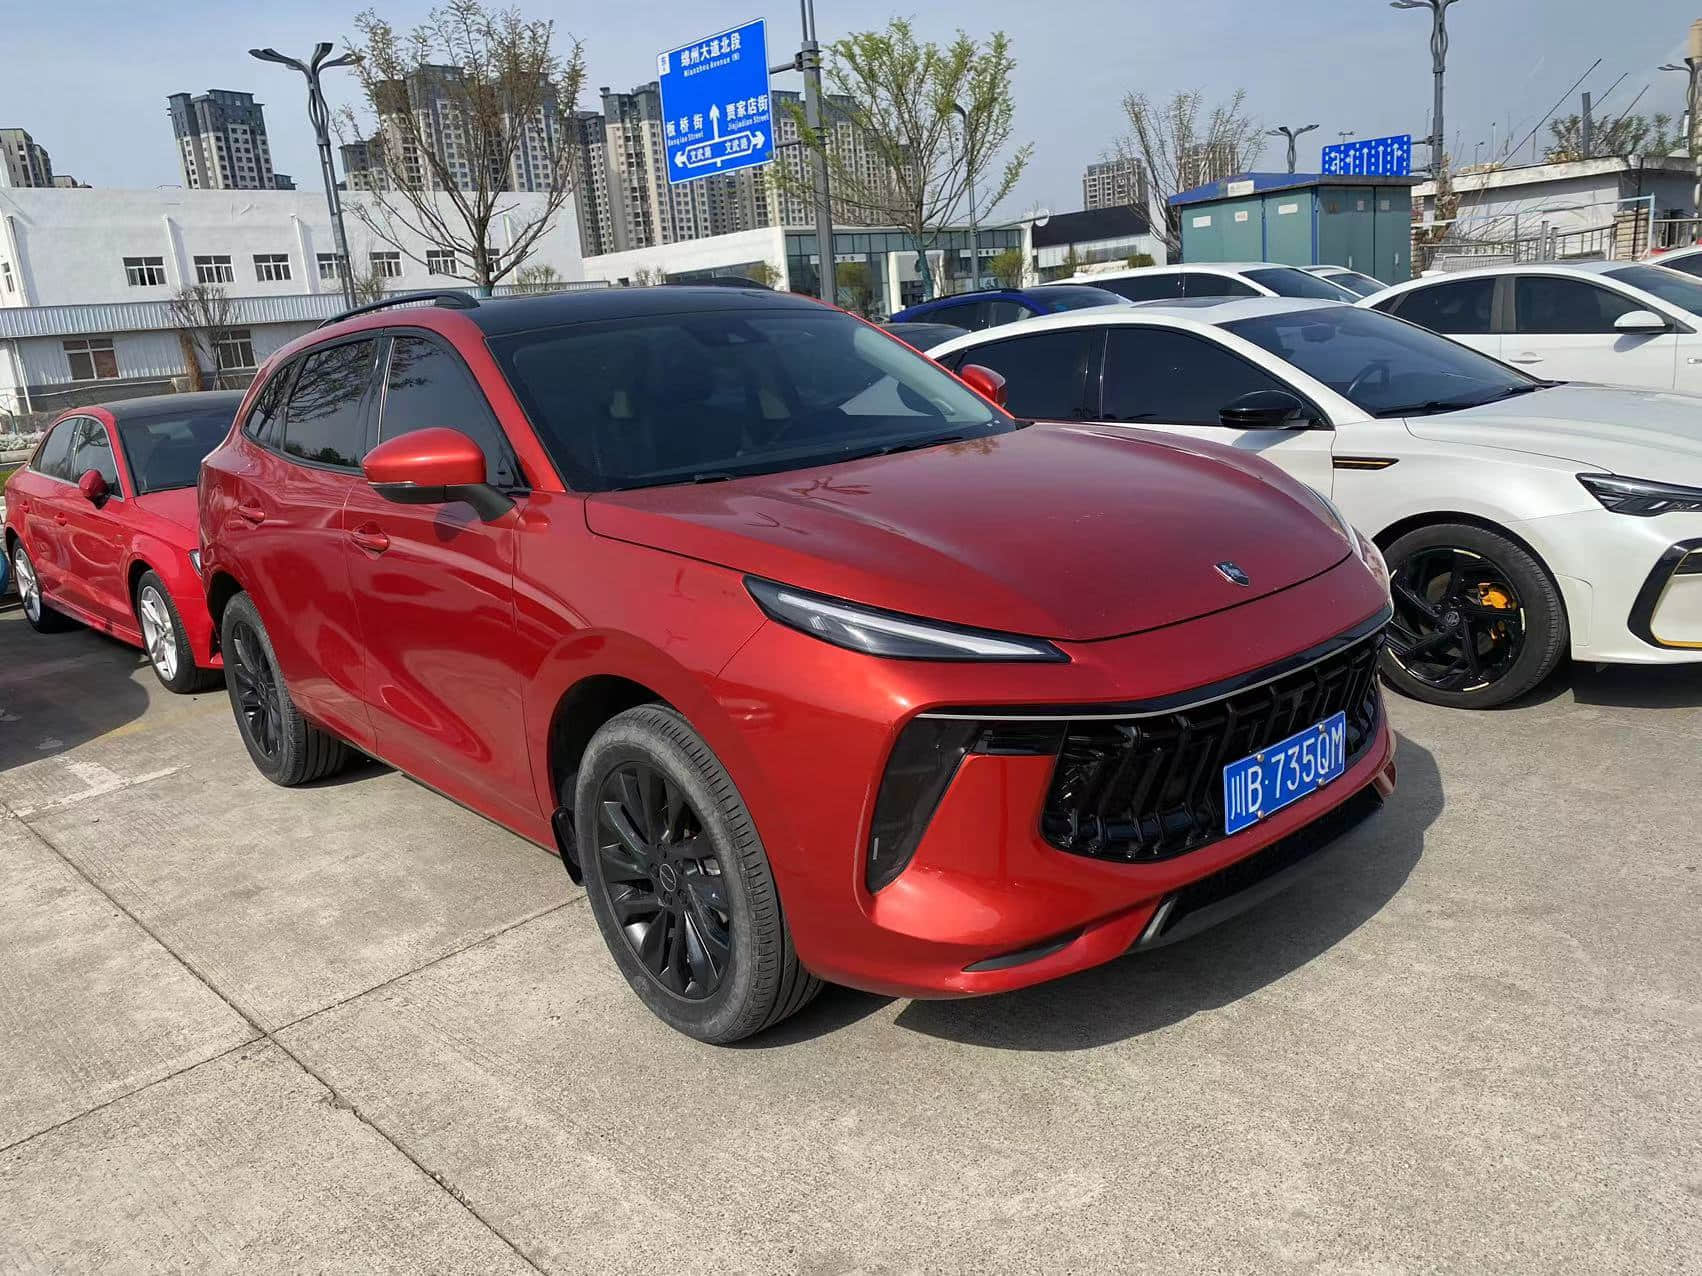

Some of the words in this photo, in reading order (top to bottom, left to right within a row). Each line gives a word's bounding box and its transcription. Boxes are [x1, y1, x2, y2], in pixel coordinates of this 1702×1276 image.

[681, 32, 741, 67] 绵州大道北段
[725, 94, 768, 121] 贾家店街
